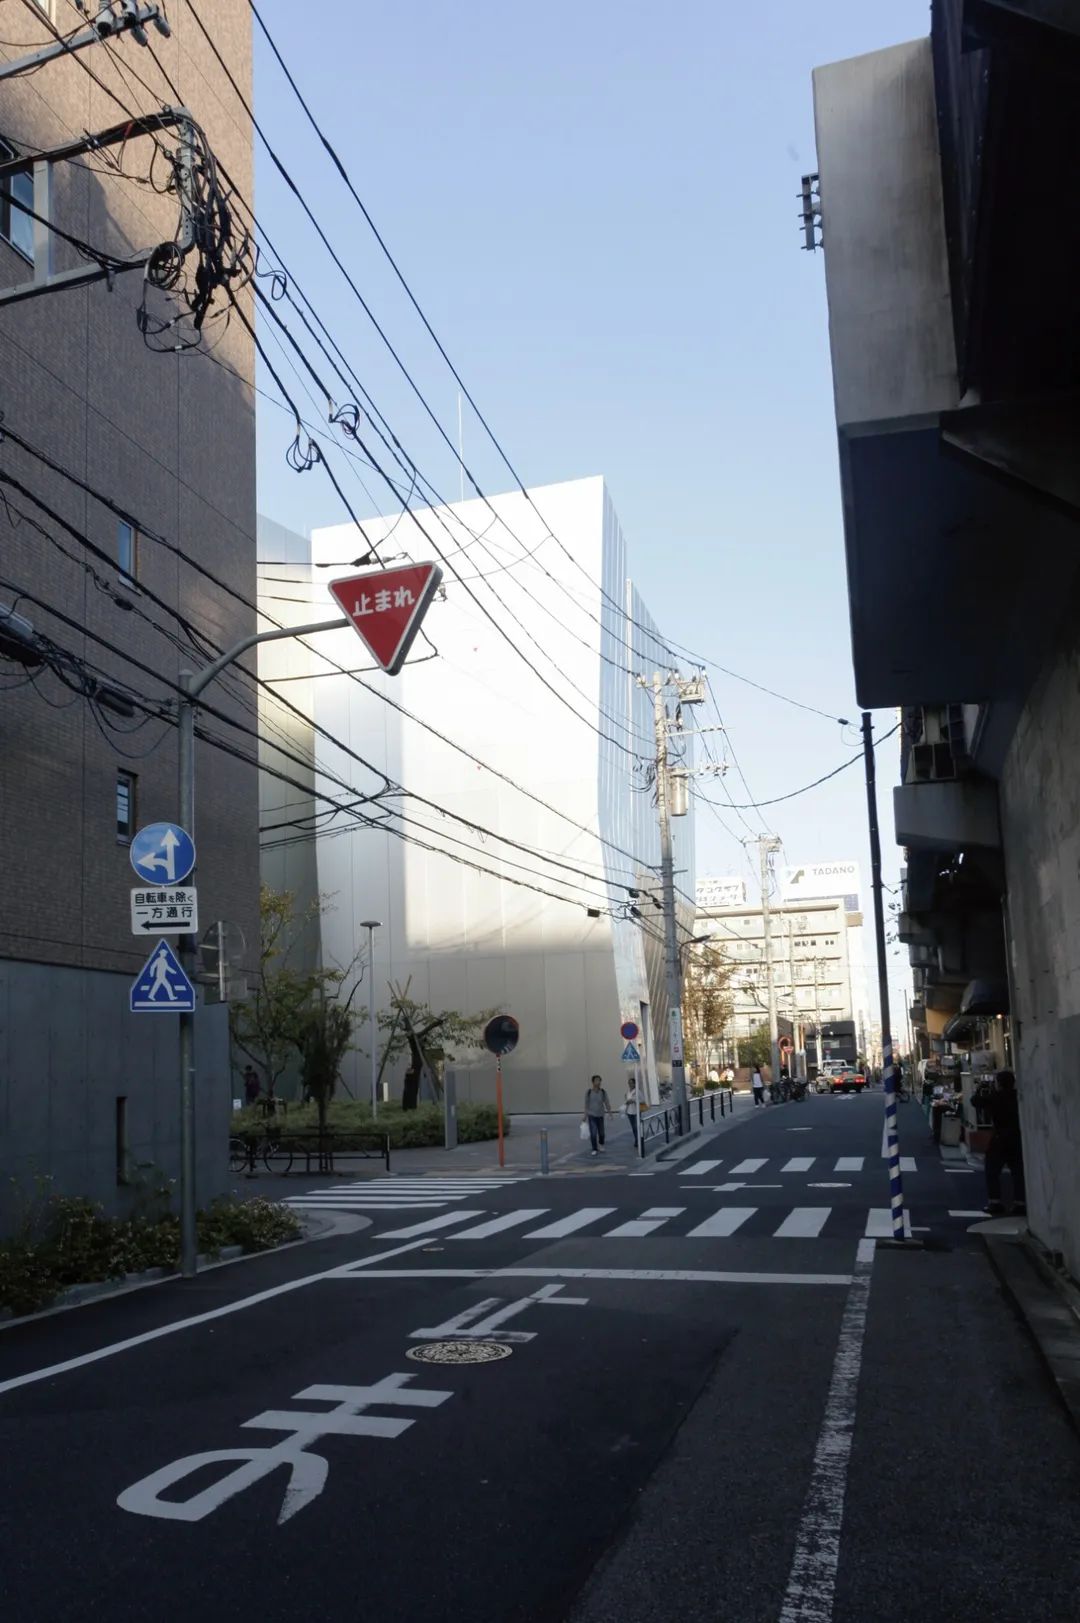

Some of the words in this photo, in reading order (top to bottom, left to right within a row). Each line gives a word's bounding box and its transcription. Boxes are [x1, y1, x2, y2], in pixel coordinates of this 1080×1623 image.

[353, 586, 415, 617] 止まれ
[812, 865, 855, 875] TADANO
[135, 891, 193, 904] 自転車を除く
[136, 906, 193, 919] 一方通行
